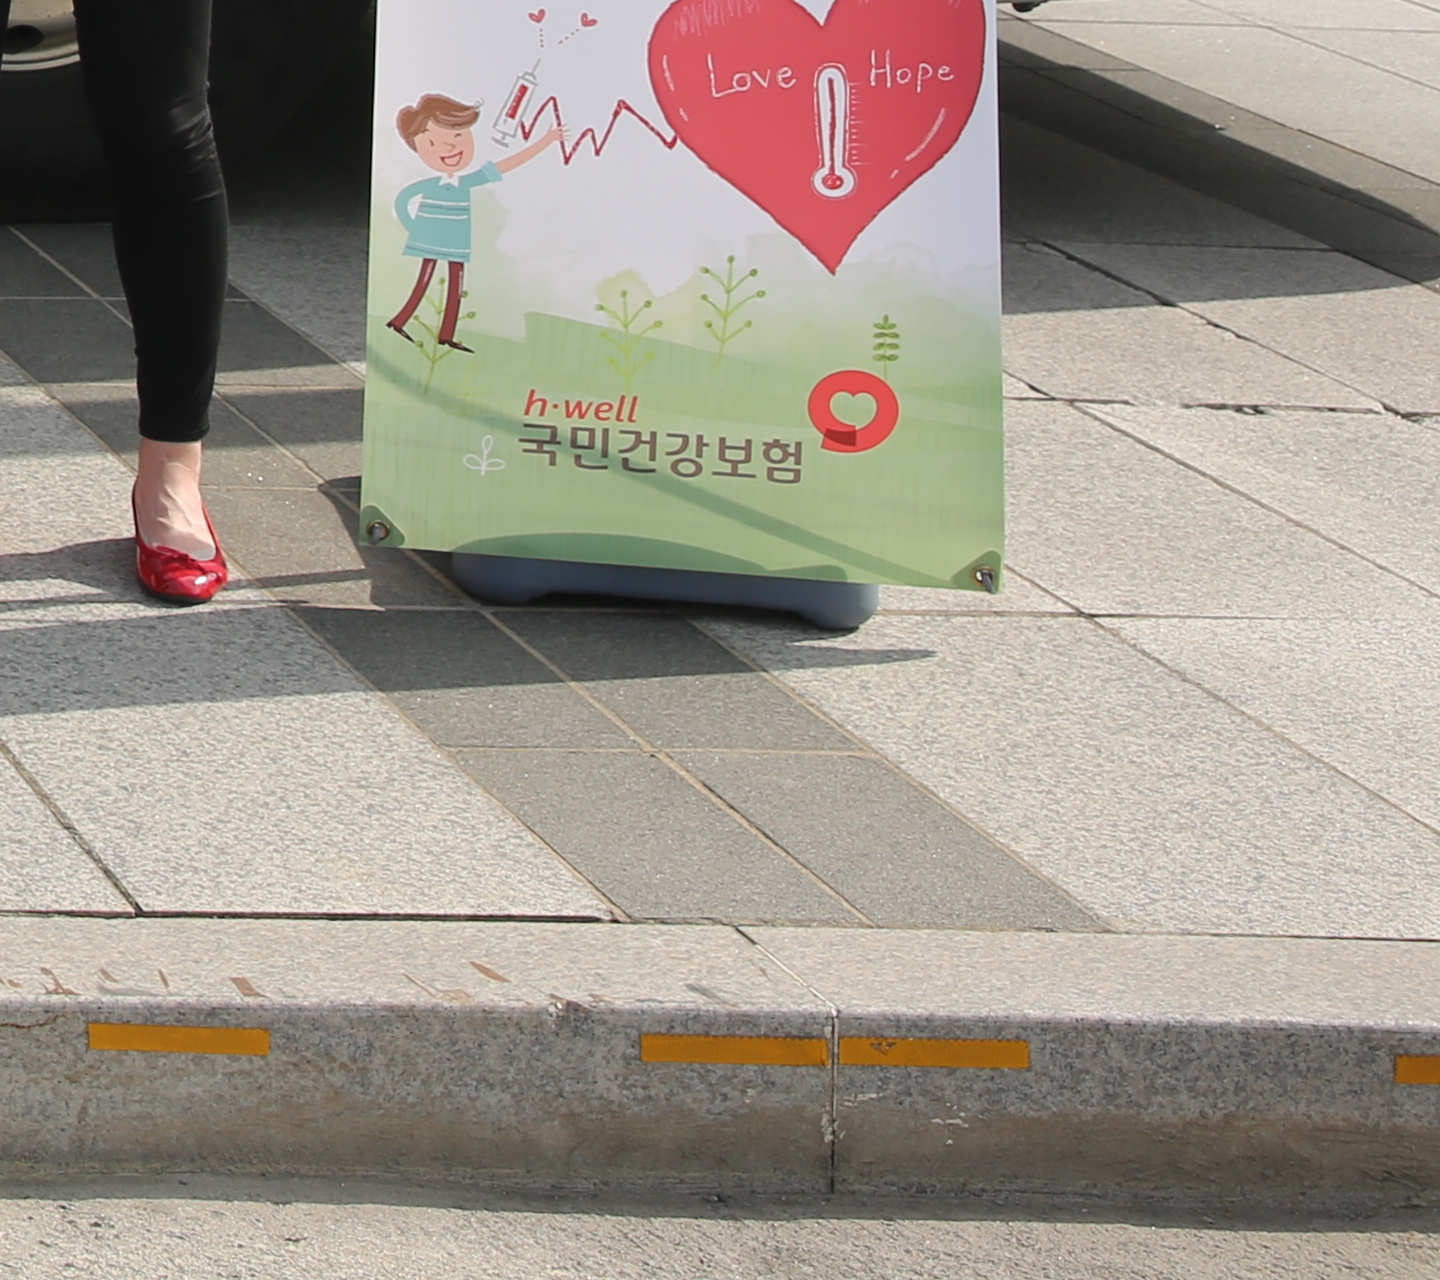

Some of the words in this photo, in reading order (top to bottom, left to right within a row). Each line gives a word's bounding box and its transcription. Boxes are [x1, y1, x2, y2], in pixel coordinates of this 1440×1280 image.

[707, 53, 797, 98] Love
[869, 48, 955, 93] Hope
[517, 421, 805, 485] 국민건강보험
